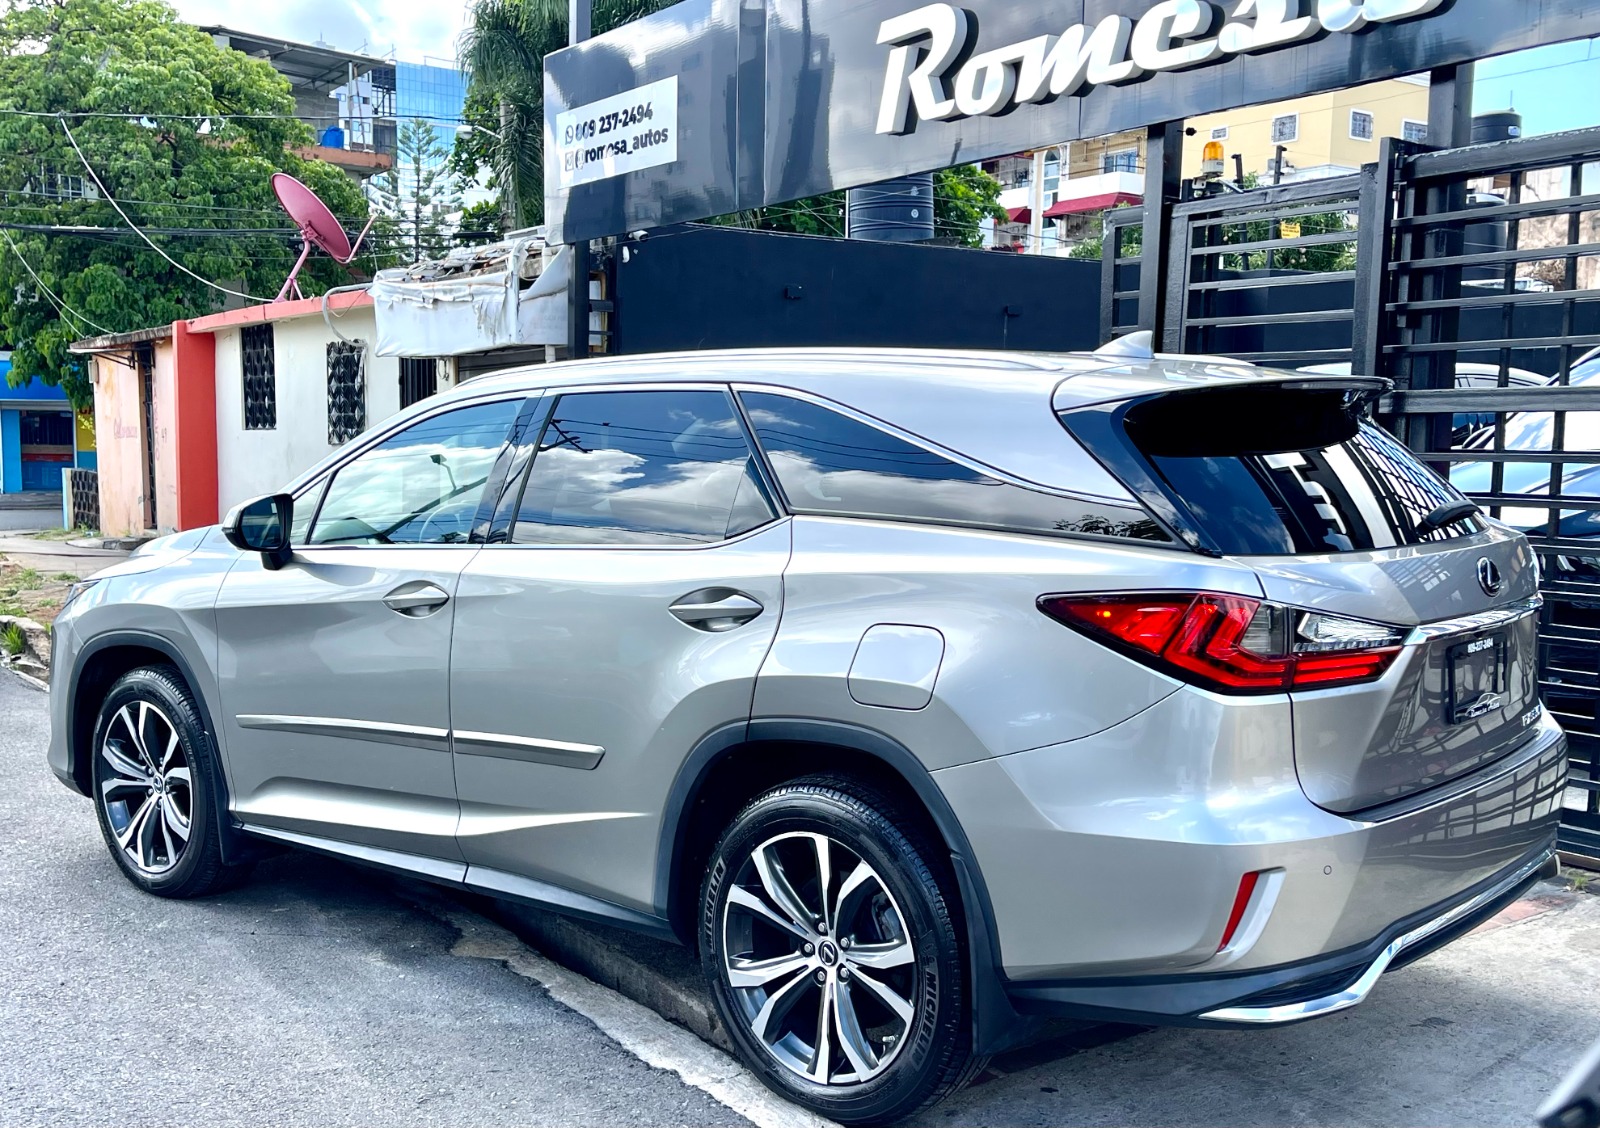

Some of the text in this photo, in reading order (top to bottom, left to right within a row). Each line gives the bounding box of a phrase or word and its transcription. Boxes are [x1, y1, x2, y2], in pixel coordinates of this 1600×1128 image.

[599, 102, 654, 134] 237-2494
[704, 857, 727, 953] MICHELIN
[911, 967, 938, 1071] MICHELIN
